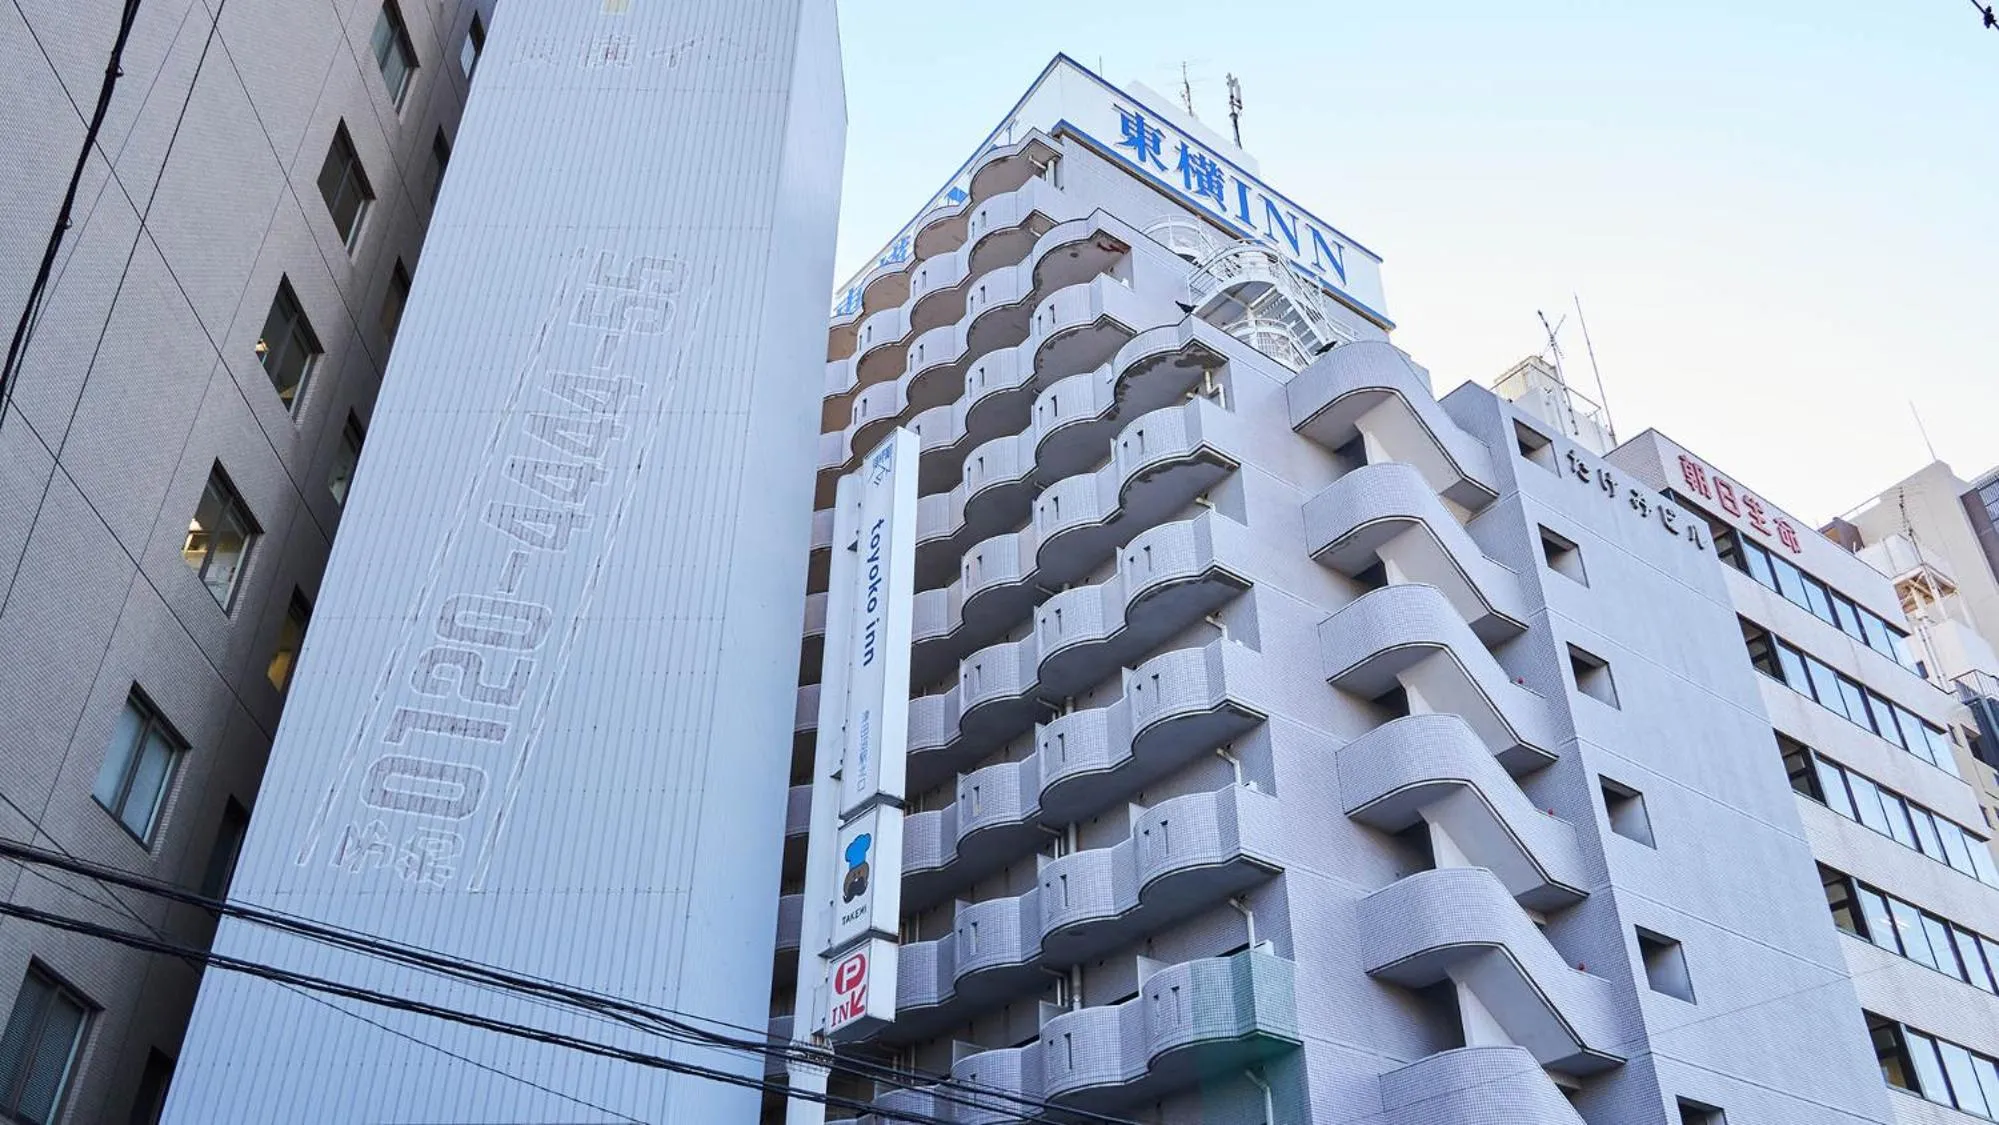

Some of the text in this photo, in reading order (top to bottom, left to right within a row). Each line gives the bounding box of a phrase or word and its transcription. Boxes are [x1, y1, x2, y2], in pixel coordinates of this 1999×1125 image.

[1112, 102, 1348, 287] 東横INN
[1678, 454, 1802, 554] 朝日生命
[863, 517, 885, 667] toyoko inn
[842, 904, 867, 926] TAKEMI
[837, 954, 865, 994] P
[831, 1001, 849, 1027] IN
